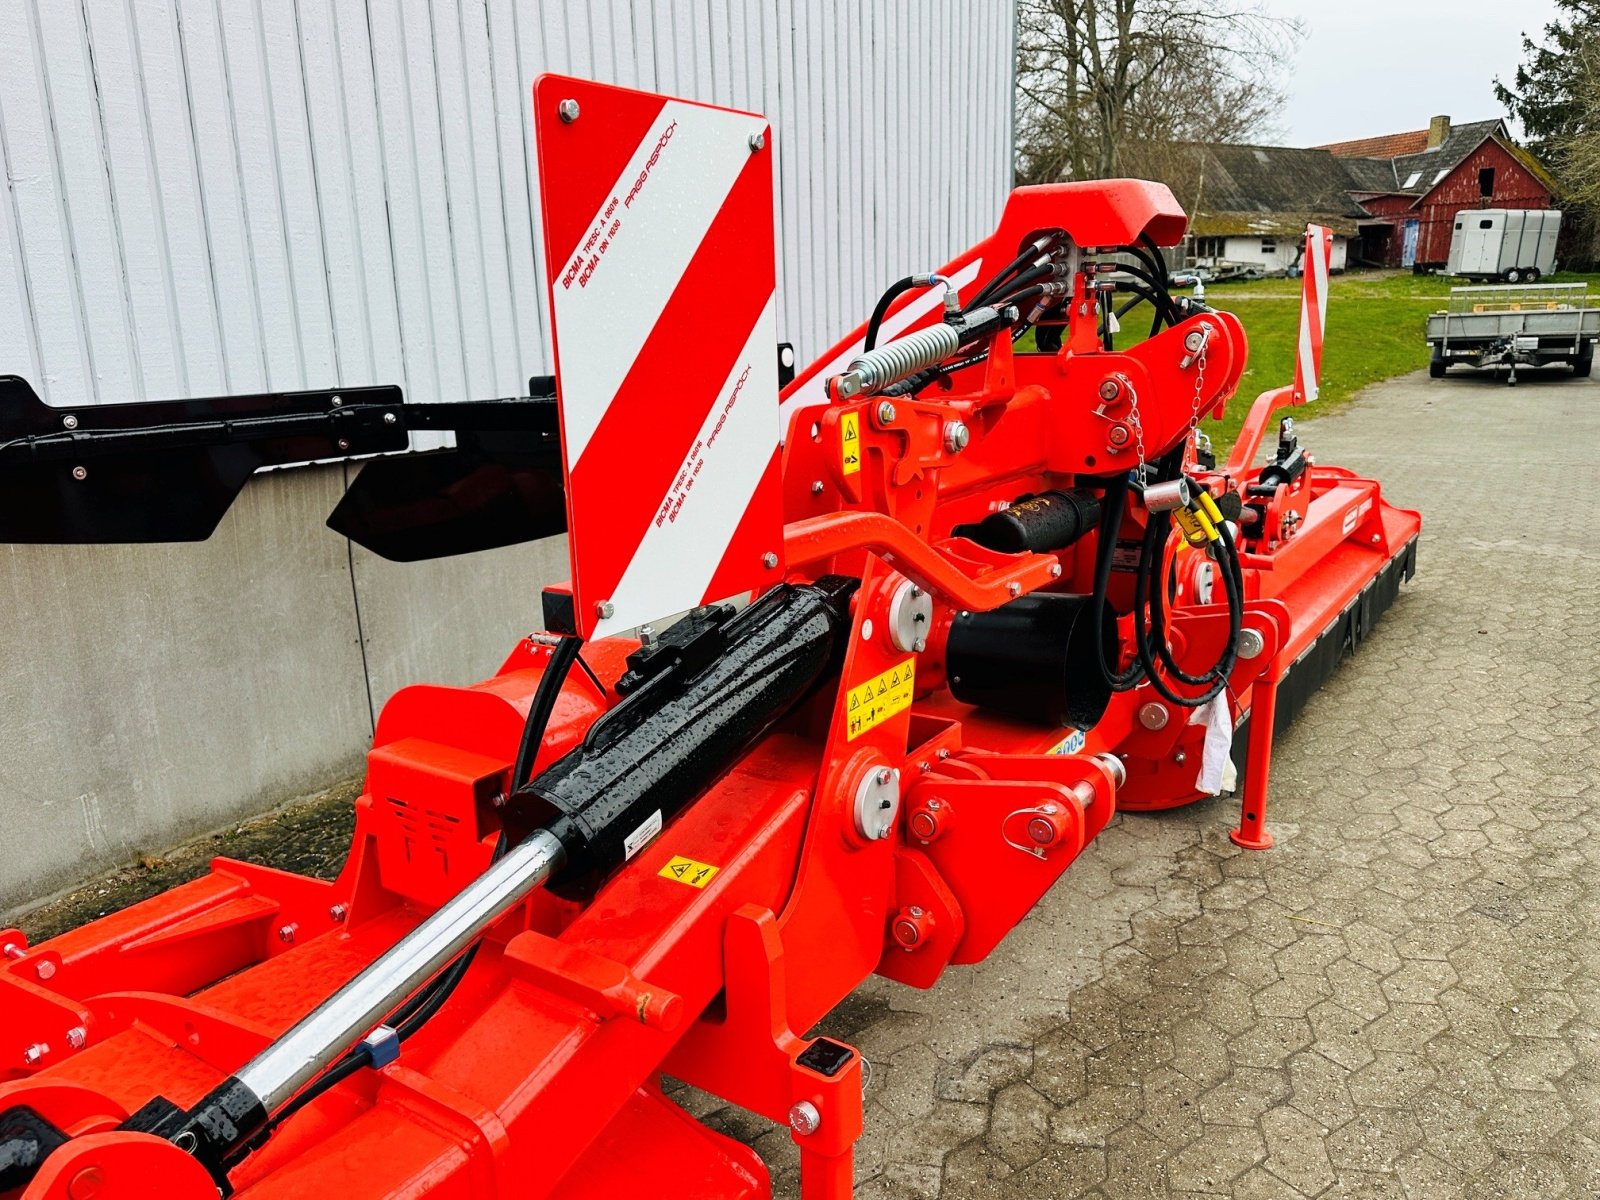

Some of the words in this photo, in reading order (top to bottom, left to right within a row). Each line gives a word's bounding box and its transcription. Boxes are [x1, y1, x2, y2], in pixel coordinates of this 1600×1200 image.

[624, 170, 648, 209] PAGG
[645, 118, 678, 173] ASPÖCK
[562, 255, 585, 290] BICMA
[604, 196, 619, 219] 06016
[578, 254, 600, 288] BICMA
[598, 238, 610, 254] DIN
[607, 219, 621, 240] 11030
[706, 413, 727, 449] PAGG
[655, 496, 674, 528] BICMA
[668, 492, 687, 524] BICMA
[685, 477, 694, 491] DIN
[692, 458, 704, 477] 11030
